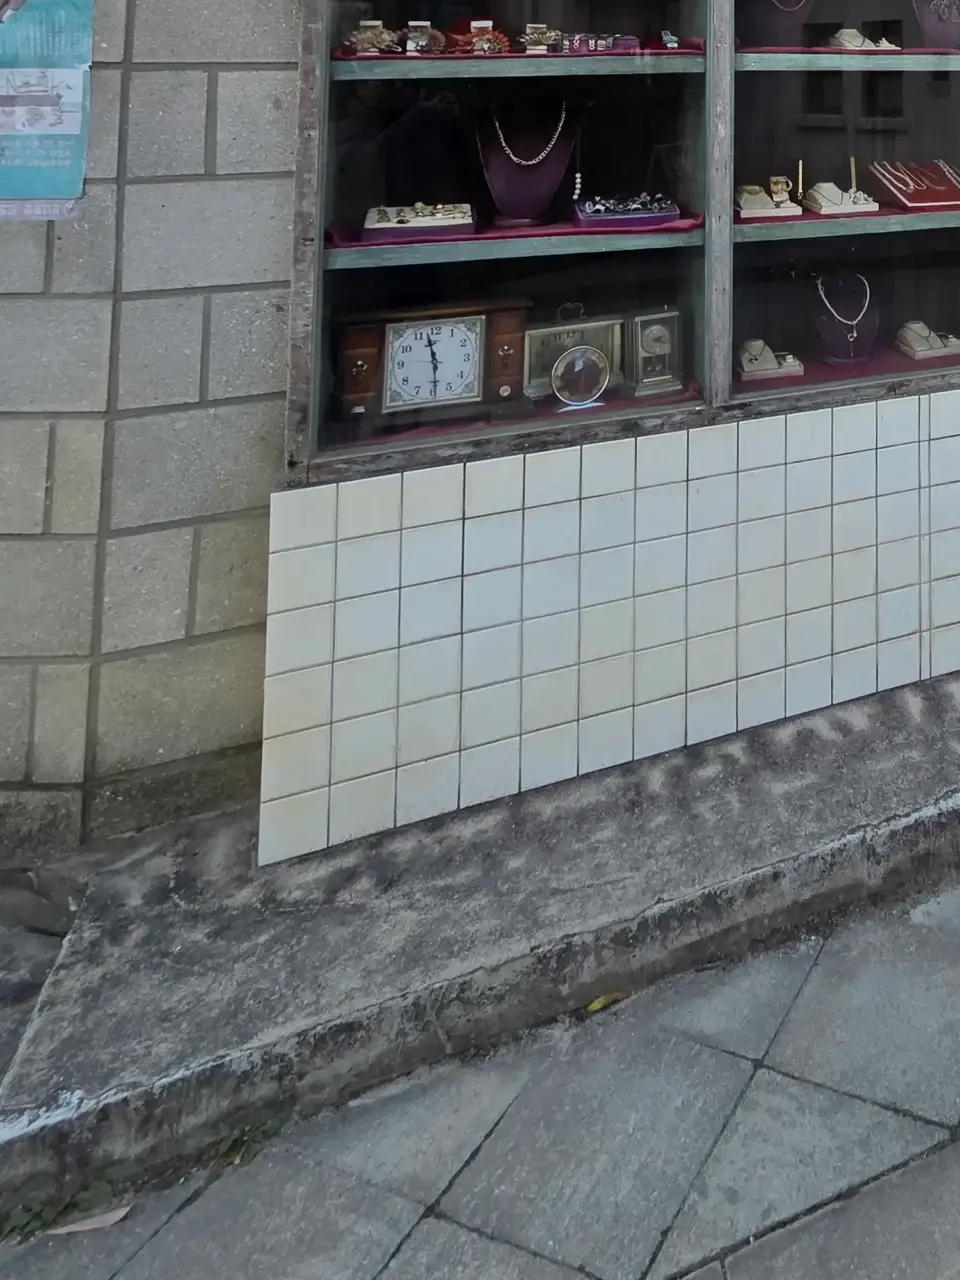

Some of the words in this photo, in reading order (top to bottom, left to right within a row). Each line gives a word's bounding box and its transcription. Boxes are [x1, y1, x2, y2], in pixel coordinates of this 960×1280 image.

[430, 326, 442, 335] 12
[450, 328, 454, 337] 1
[414, 332, 423, 340] 11
[460, 339, 467, 347] 2
[400, 345, 412, 353] 10
[463, 353, 470, 362] 3
[397, 361, 404, 369] 9
[402, 376, 409, 385] 8
[414, 386, 421, 395] 7
[446, 382, 452, 391] 5
